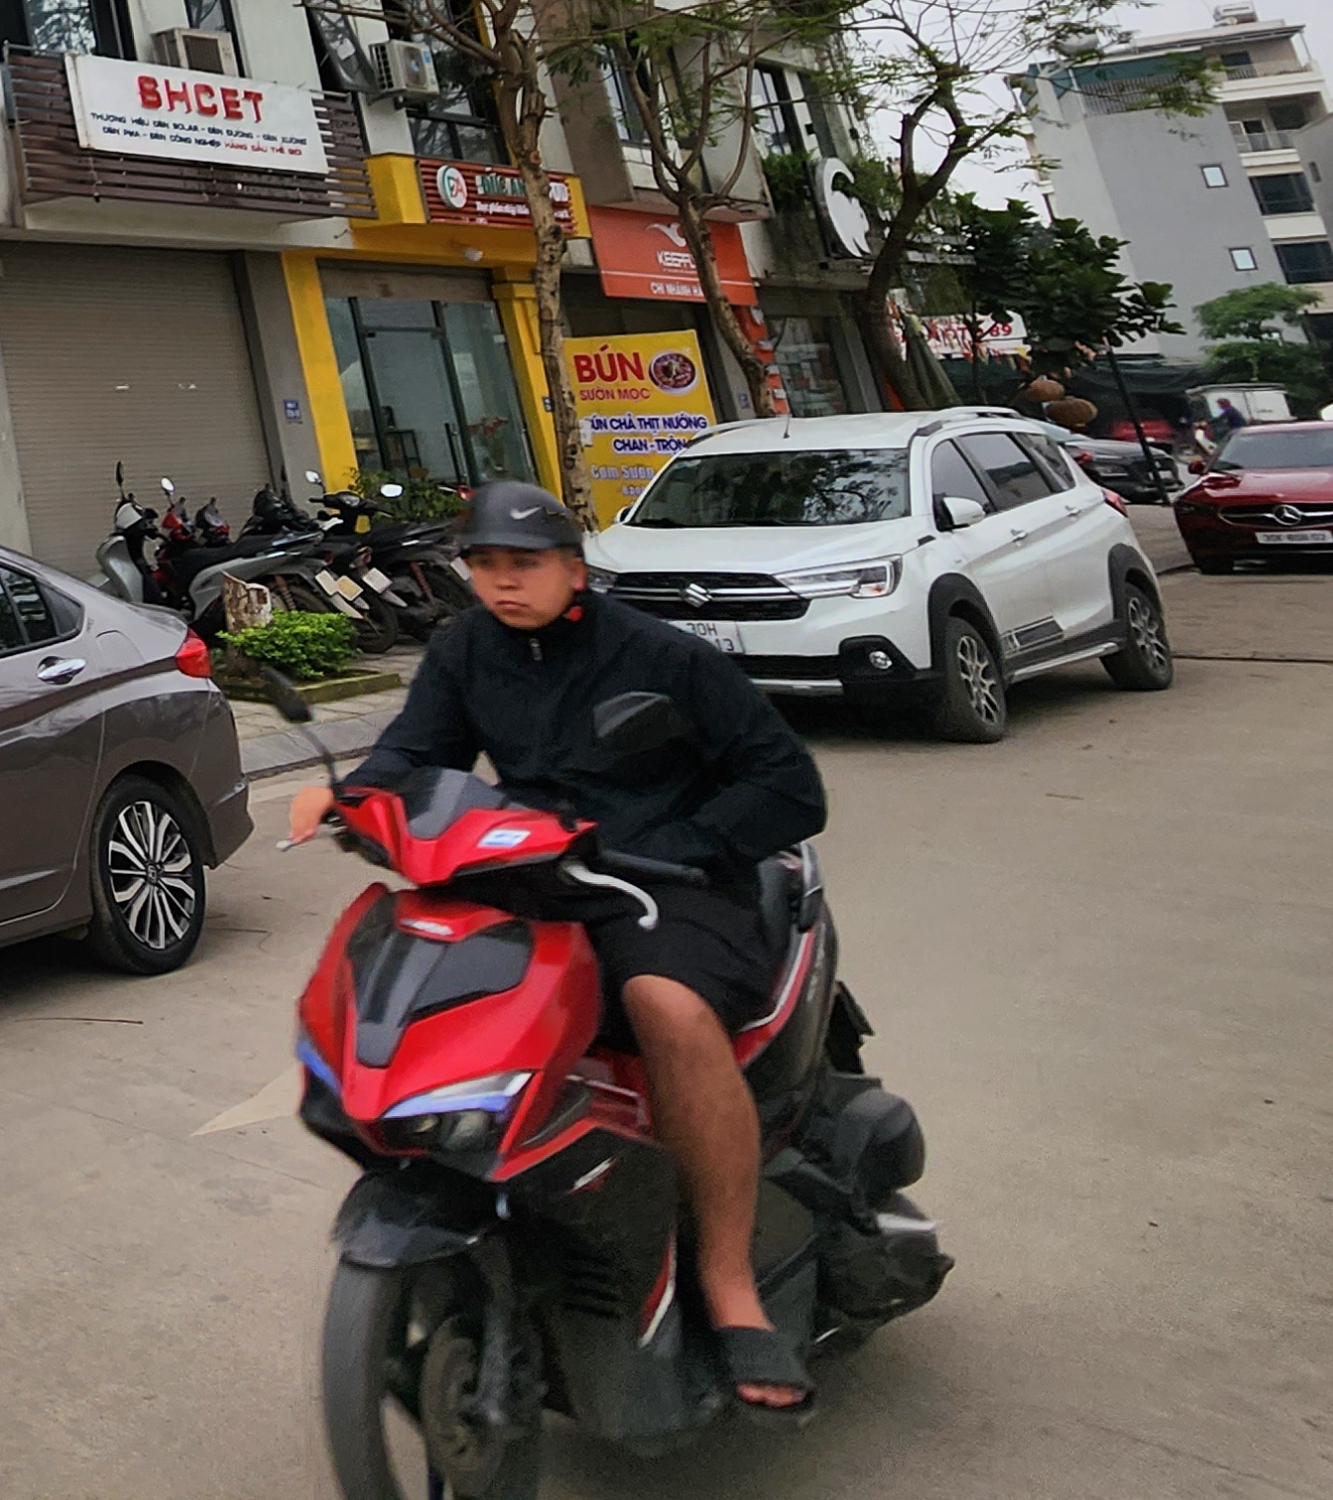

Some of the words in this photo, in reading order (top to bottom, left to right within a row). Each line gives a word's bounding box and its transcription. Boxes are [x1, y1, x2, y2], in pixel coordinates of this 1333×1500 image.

[137, 75, 263, 123] BHCET
[573, 344, 645, 384] BÚN
[609, 413, 637, 431] CHẢ
[636, 416, 660, 434] THỊT
[662, 412, 708, 430] NƯỚNG
[613, 438, 649, 452] CHAN
